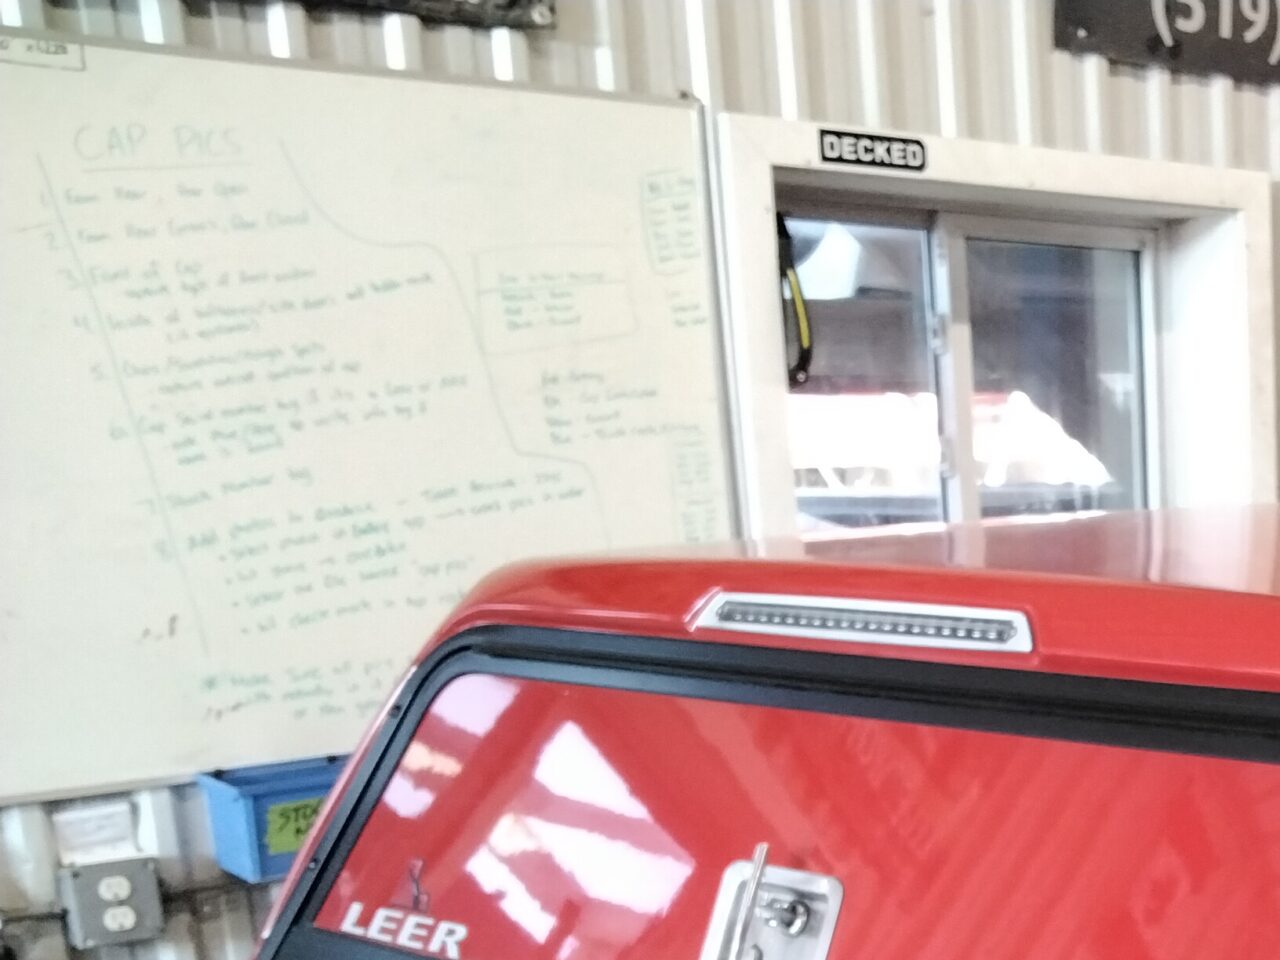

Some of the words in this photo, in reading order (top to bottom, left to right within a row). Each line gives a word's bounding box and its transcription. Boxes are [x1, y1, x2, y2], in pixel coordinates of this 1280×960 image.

[74, 123, 146, 160] CAP
[822, 133, 925, 167] DECKED
[340, 901, 468, 960] LEER
